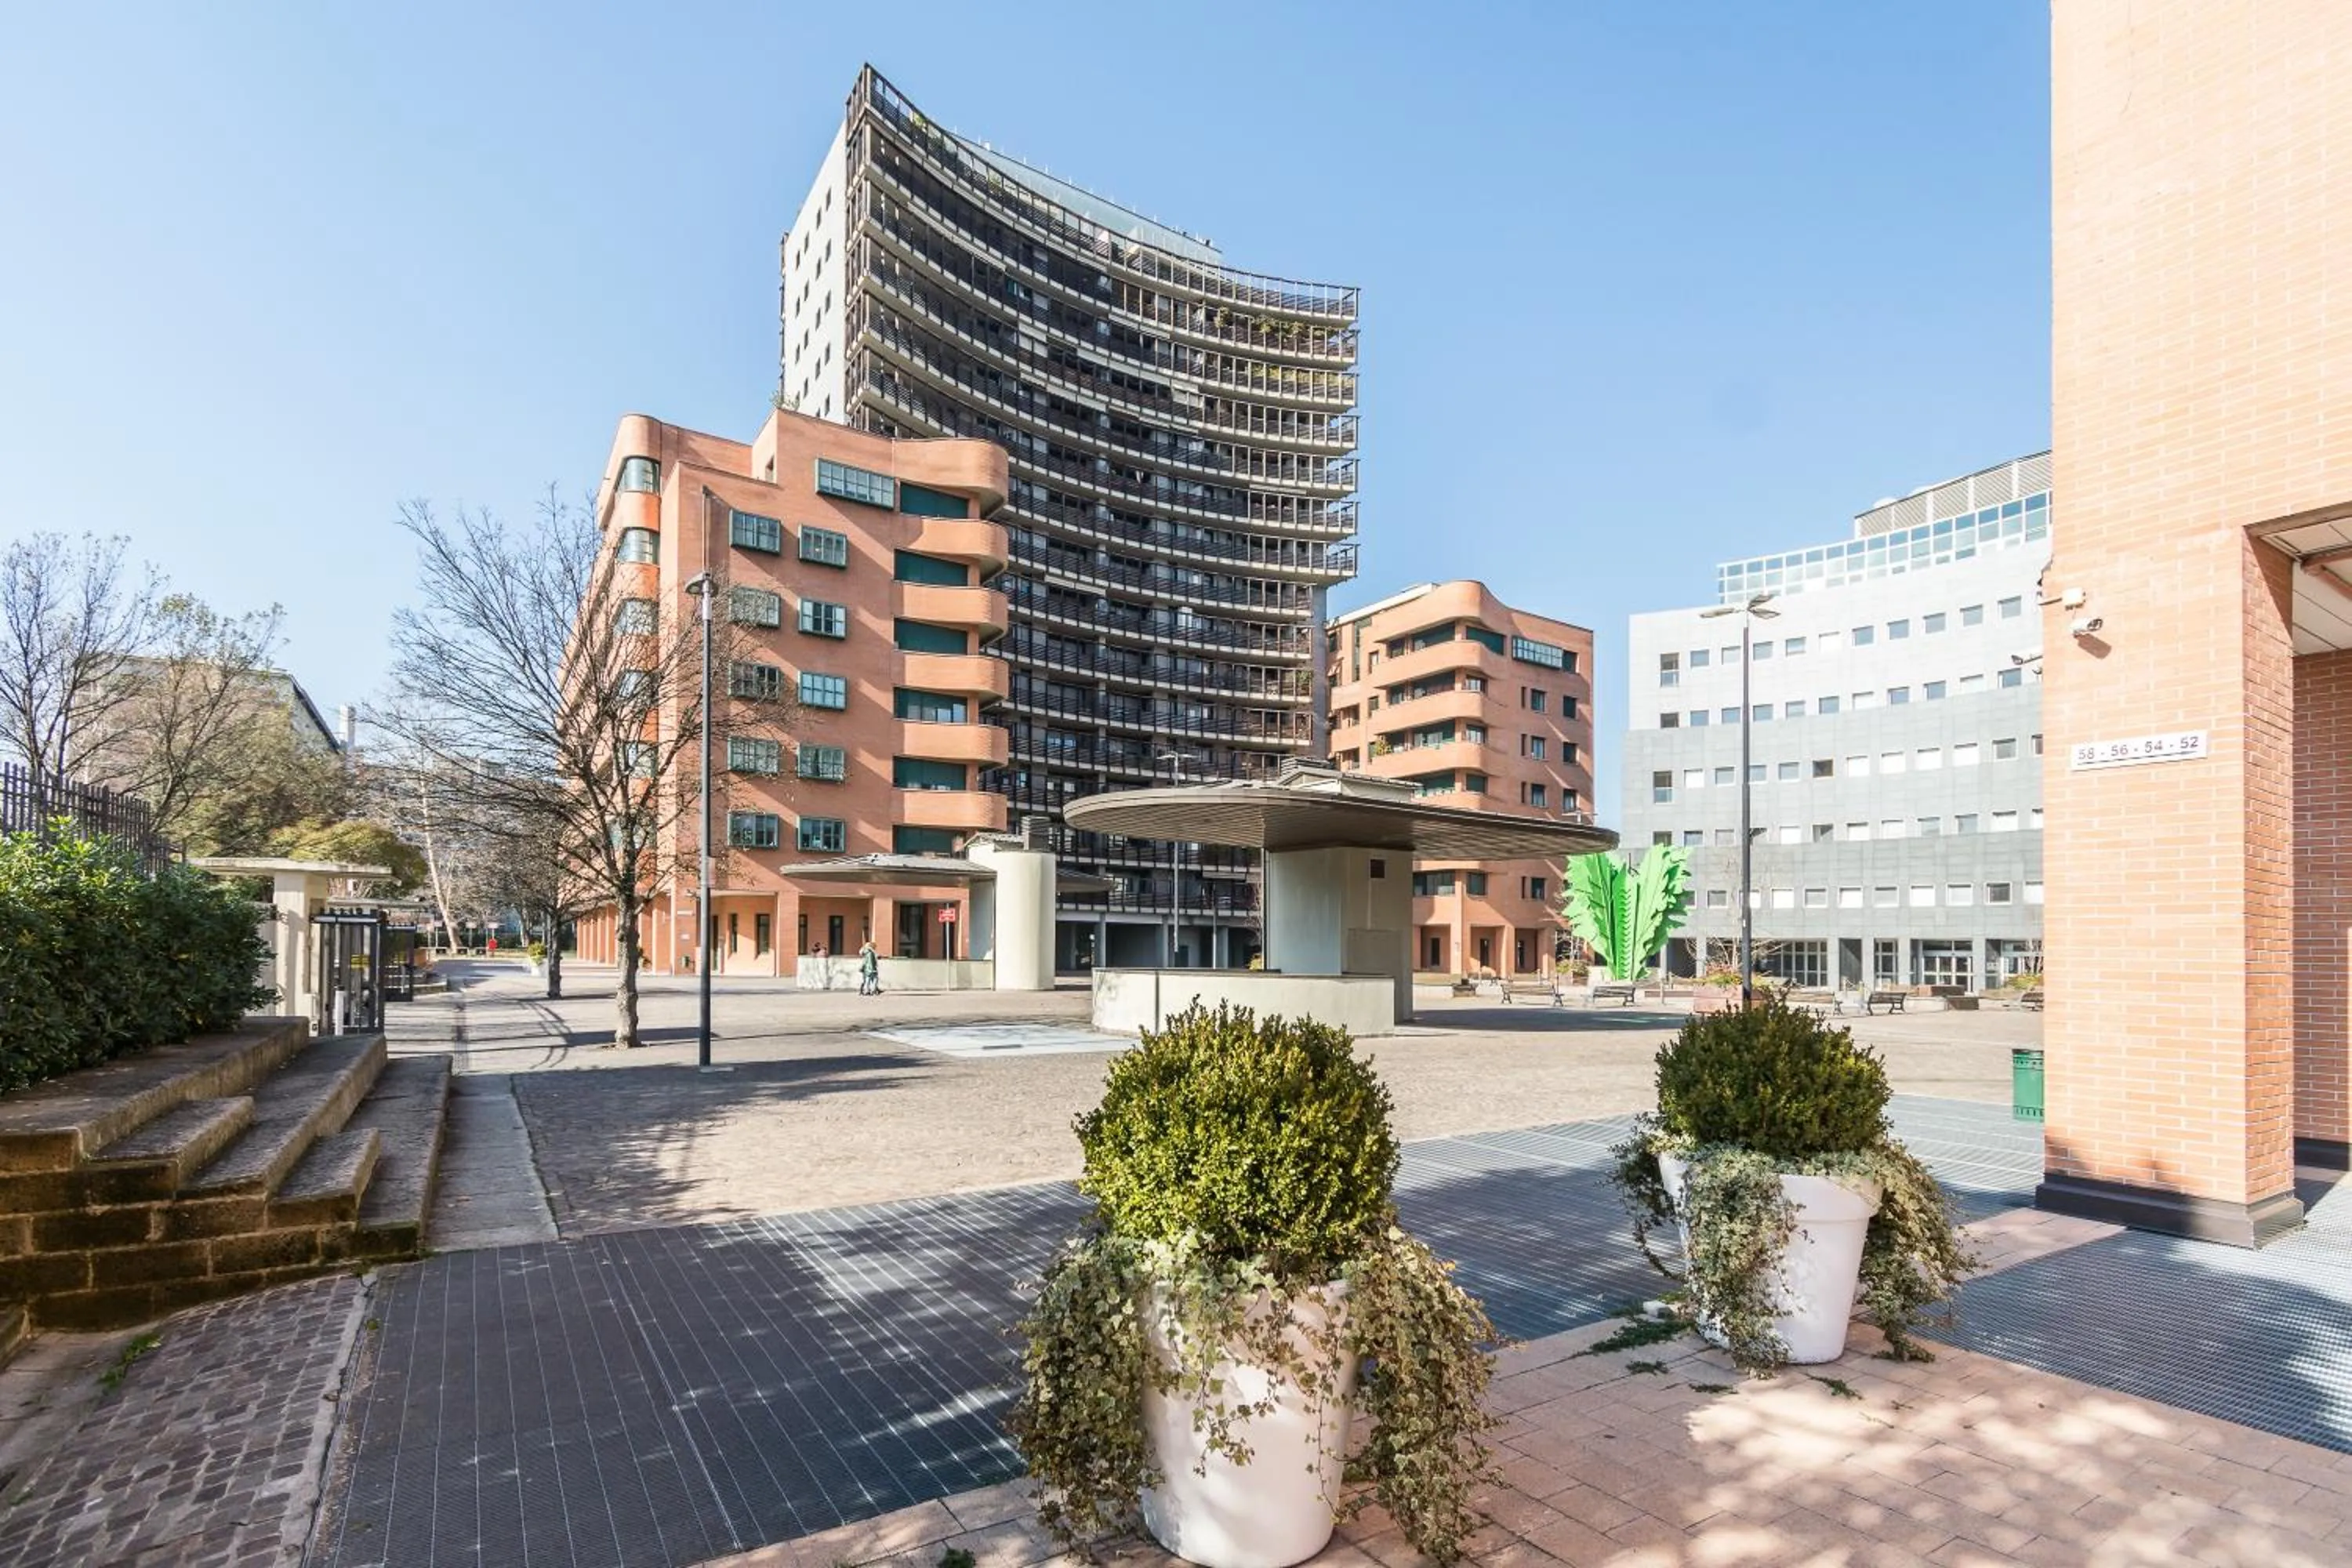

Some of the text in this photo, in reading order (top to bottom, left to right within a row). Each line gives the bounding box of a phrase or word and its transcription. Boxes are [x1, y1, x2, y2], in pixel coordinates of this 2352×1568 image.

[2078, 747, 2096, 760] 58
[2111, 745, 2129, 757] 56
[2144, 740, 2163, 753] 54
[2180, 736, 2198, 749] 52
